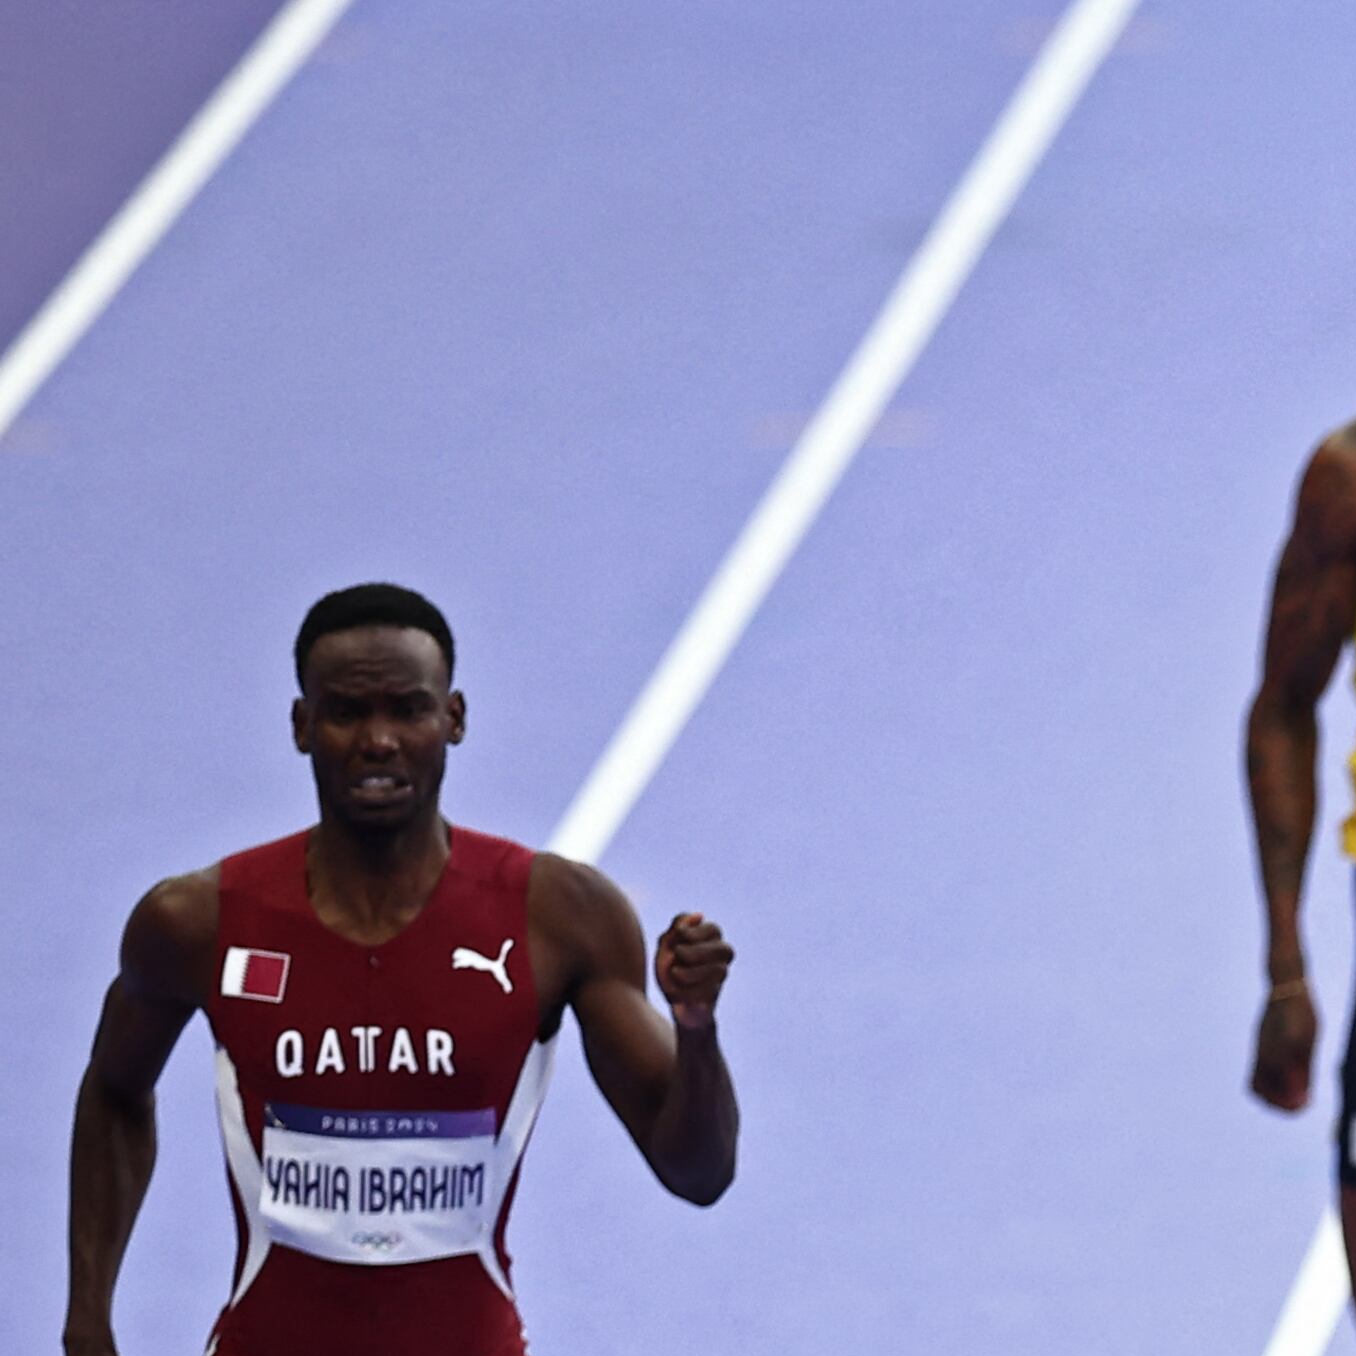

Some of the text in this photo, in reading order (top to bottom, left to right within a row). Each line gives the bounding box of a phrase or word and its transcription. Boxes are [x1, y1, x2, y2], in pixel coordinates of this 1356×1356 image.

[276, 1026, 456, 1078] QATAR
[266, 1157, 485, 1215] YAHIA IBRAHIM
